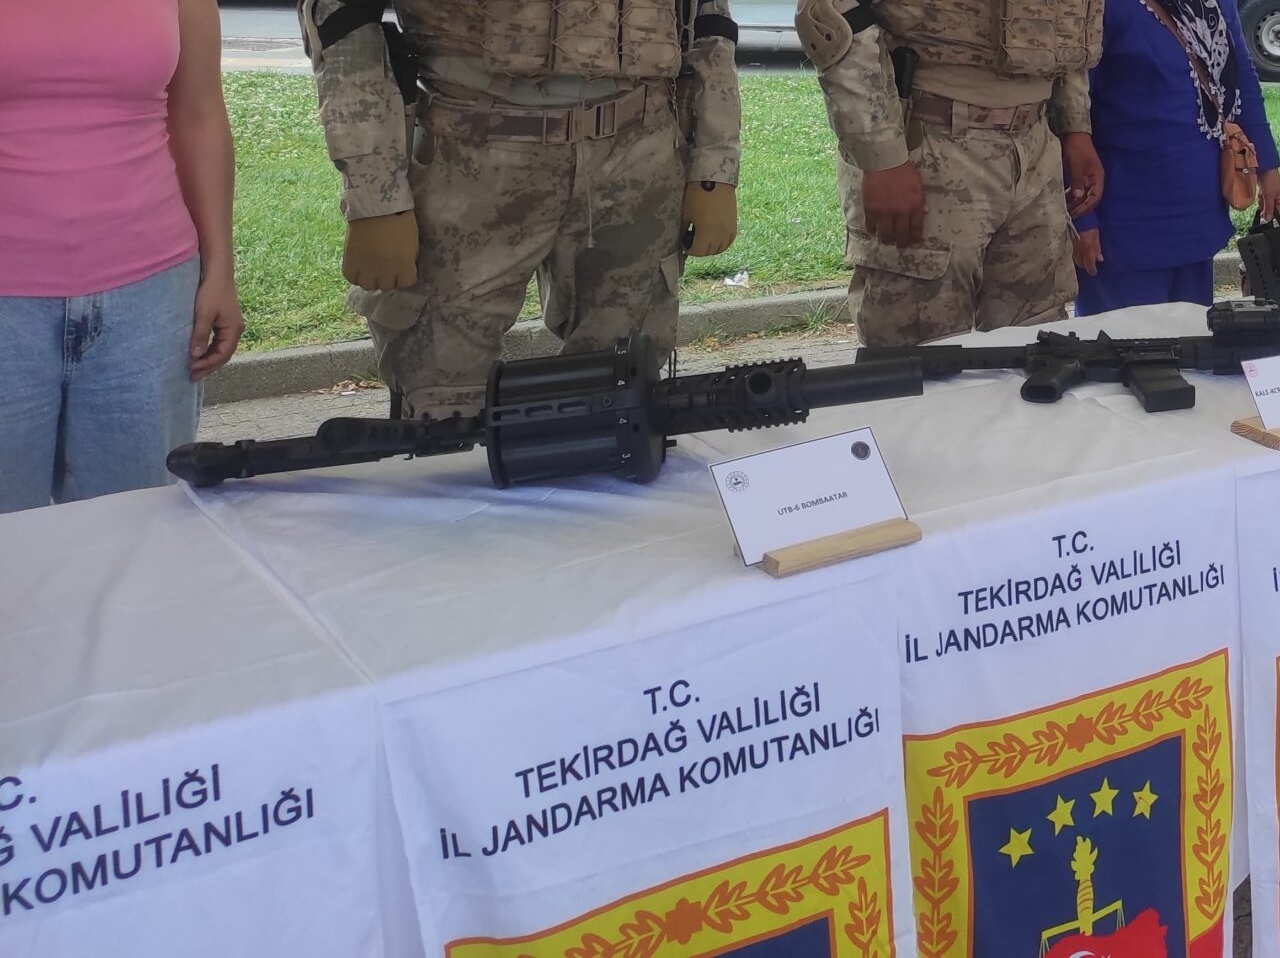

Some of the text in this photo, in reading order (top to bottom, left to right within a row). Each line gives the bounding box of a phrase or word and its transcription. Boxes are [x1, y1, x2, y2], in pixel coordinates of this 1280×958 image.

[777, 491, 848, 516] UTB-6 BOMBAATAR
[1052, 530, 1094, 558] T.C.
[905, 563, 1225, 663] İL JANDARMA KOMUTANLIĞI
[958, 540, 1181, 615] TEKİRDAĞ VALİLİĞİ
[515, 682, 821, 799] TEKİRDAĞ VALİLİĞİ
[643, 679, 700, 715] T.C.
[30, 764, 221, 853] VALİLİĞİ
[440, 708, 880, 859] İL JANDARMA KOMUTANLIĞI
[1, 788, 314, 916] KOMUTANLIĞI
